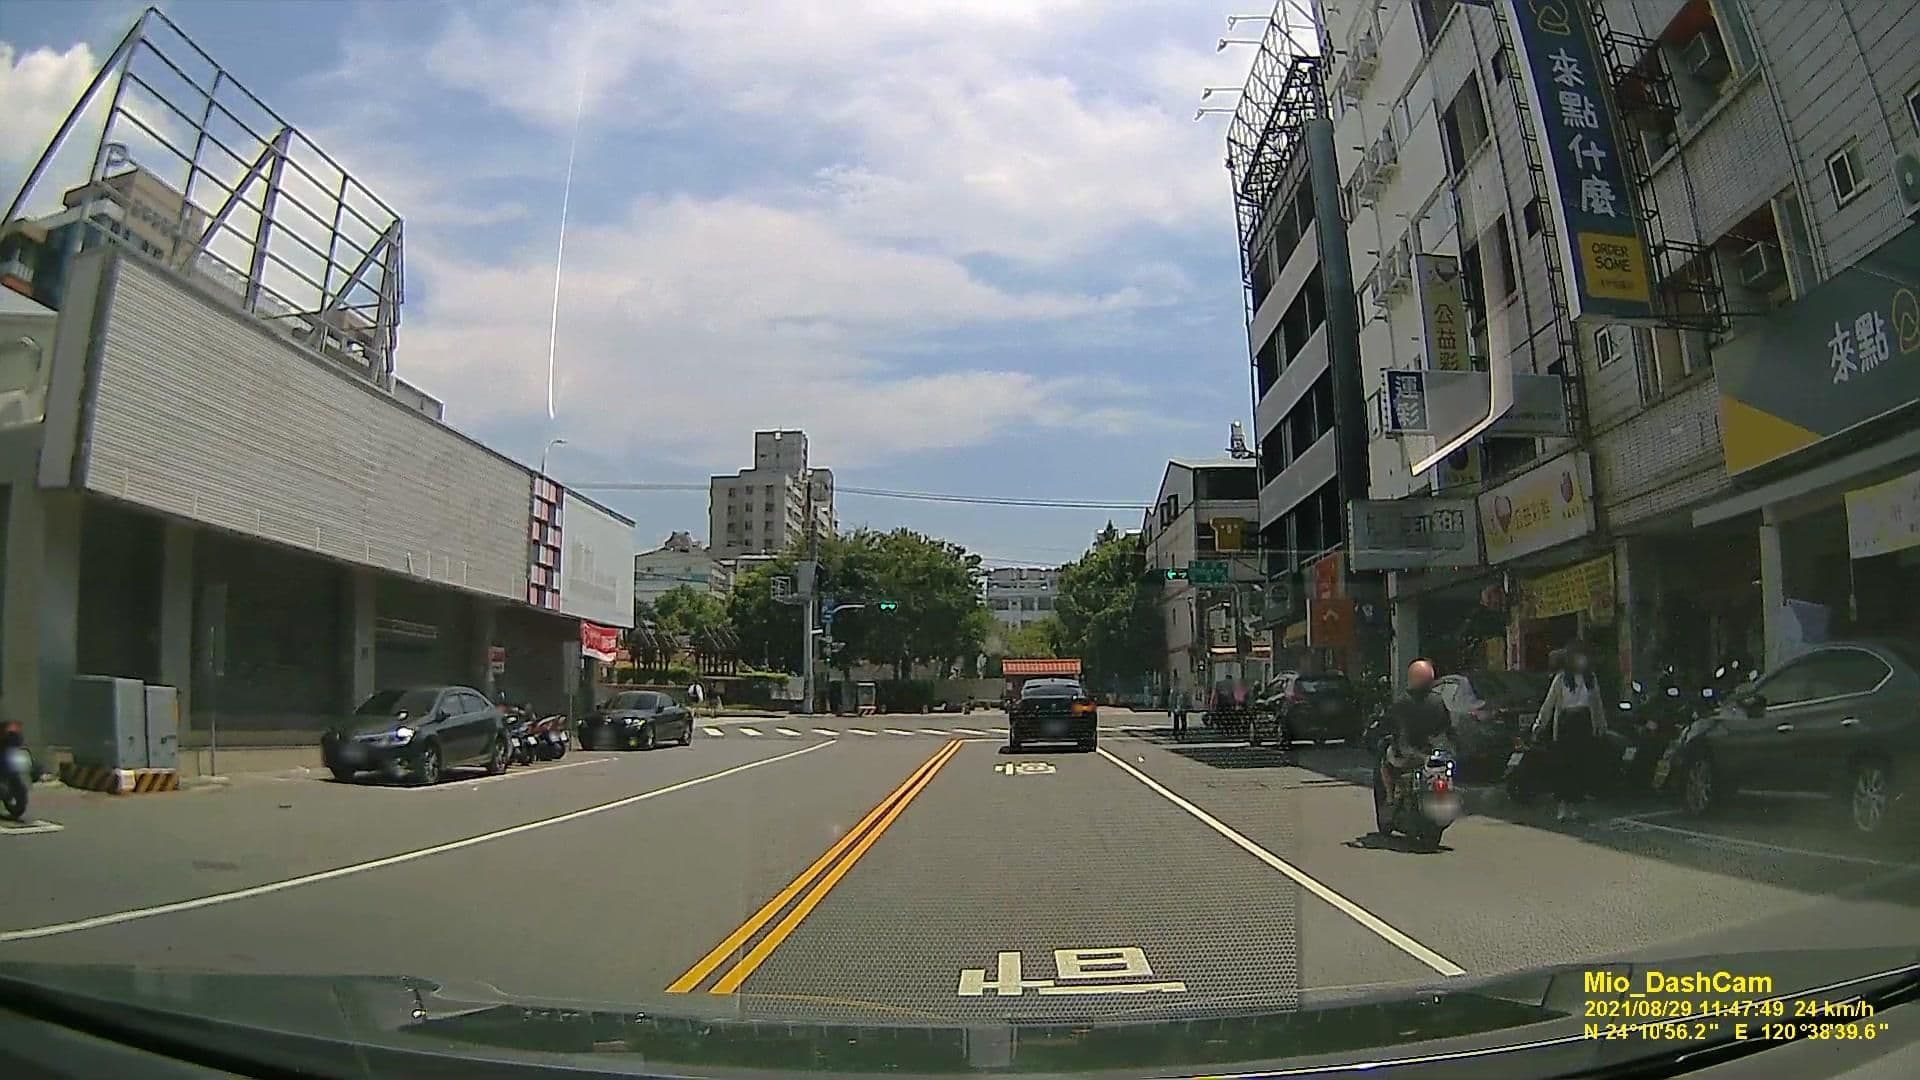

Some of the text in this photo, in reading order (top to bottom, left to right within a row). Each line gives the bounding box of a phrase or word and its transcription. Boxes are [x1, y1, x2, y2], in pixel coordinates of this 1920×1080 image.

[1548, 48, 1616, 218] 來點什麼
[1591, 242, 1629, 258] ORDER
[1594, 256, 1632, 273] SOME
[1827, 310, 1889, 384] 來點
[1395, 375, 1420, 427] 運彩
